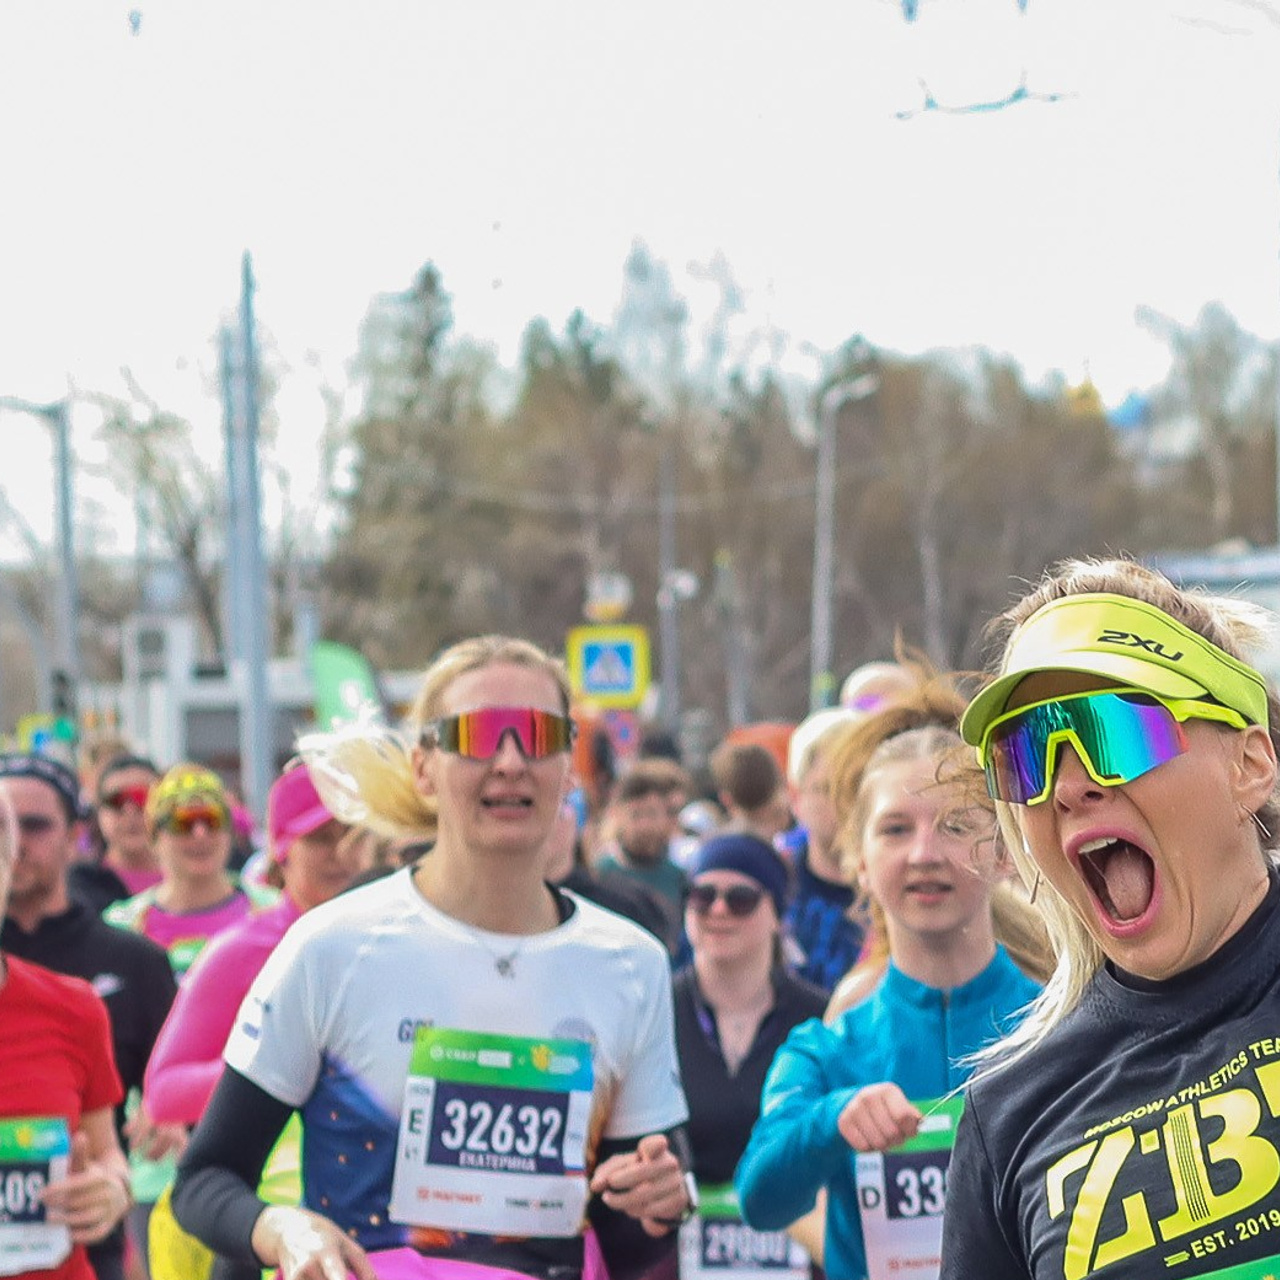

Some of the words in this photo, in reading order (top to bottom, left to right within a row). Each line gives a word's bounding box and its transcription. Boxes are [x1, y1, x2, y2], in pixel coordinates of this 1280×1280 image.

[1098, 630, 1183, 661] 2XU
[1083, 1098, 1164, 1139] MOSCOW
[1165, 1050, 1248, 1108] ATHLETICS
[409, 1108, 424, 1134] E
[441, 1099, 563, 1158] 32632
[0, 1171, 46, 1213] 09
[861, 1186, 880, 1209] D
[896, 1166, 950, 1217] 33
[1191, 1228, 1235, 1259] EST.
